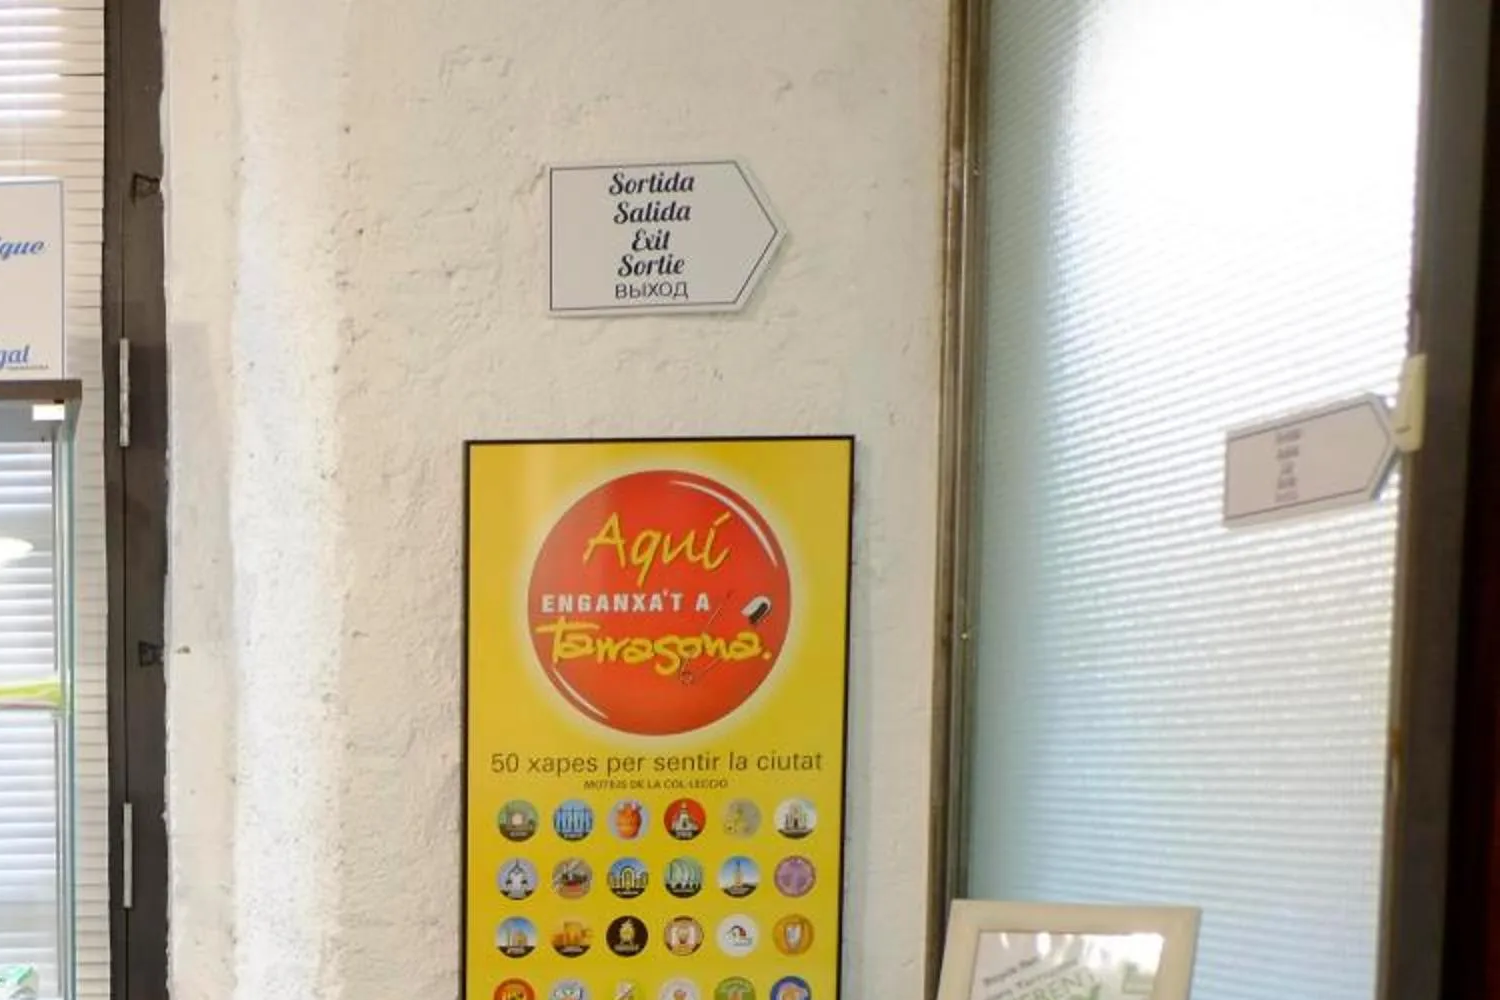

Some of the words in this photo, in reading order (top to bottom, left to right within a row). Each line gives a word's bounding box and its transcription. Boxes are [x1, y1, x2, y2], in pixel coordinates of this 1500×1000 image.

[608, 171, 695, 196] Sortida
[613, 201, 692, 225] Salida
[631, 228, 671, 252] Exit
[617, 254, 686, 277] Sortie
[582, 511, 733, 587] Aquí
[541, 588, 684, 614] ENGANXA'T
[694, 591, 712, 612] A
[491, 752, 520, 774] 50
[527, 755, 599, 778] xapes
[607, 755, 647, 777] per
[653, 752, 721, 772] sentir
[729, 751, 748, 771] la
[757, 750, 822, 771] ciutat
[647, 779, 661, 789] LA
